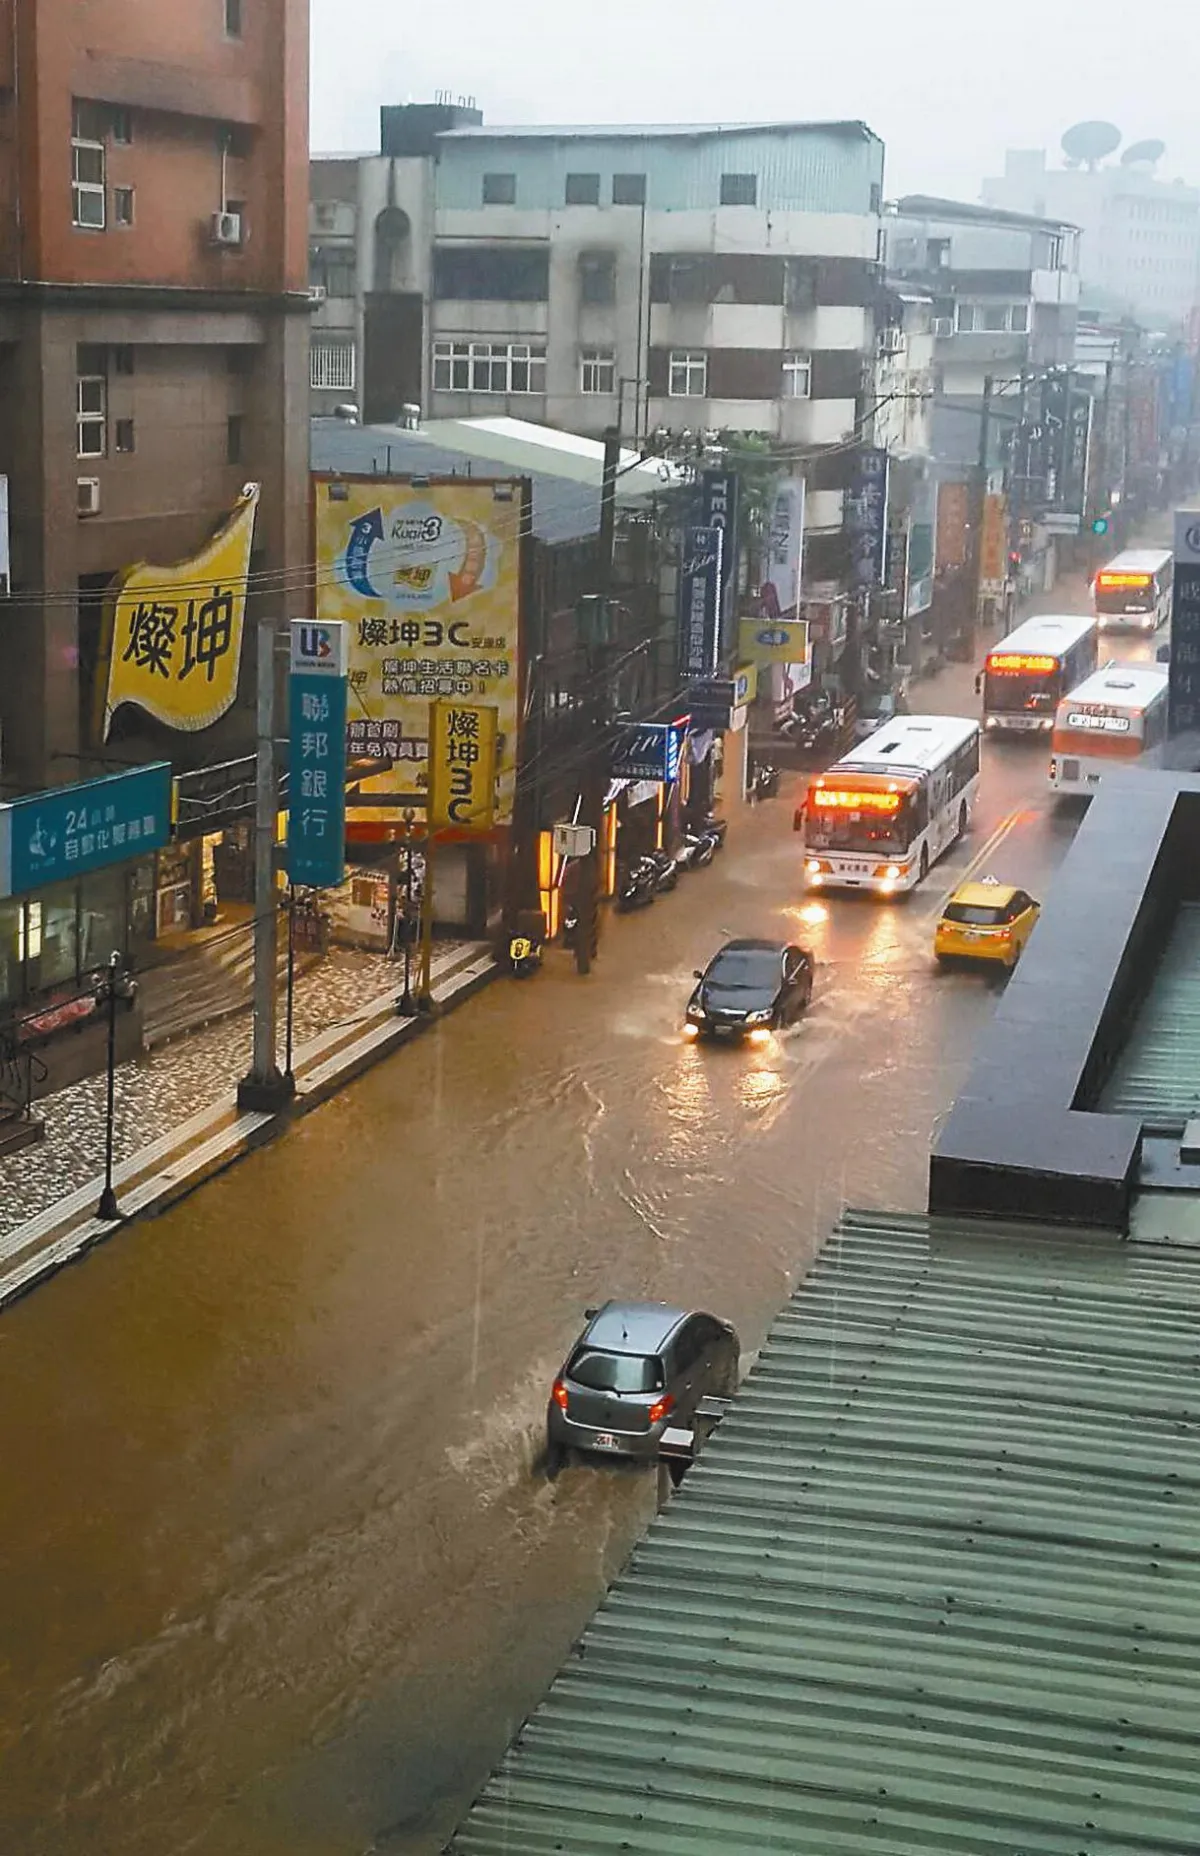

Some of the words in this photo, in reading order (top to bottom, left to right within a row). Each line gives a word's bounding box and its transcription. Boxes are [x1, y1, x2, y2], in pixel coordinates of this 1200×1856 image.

[123, 584, 234, 682] 燦坤
[358, 618, 470, 647] 燦坤3C
[301, 692, 329, 838] 聯邦銀行
[446, 709, 480, 824] 燦坤3C
